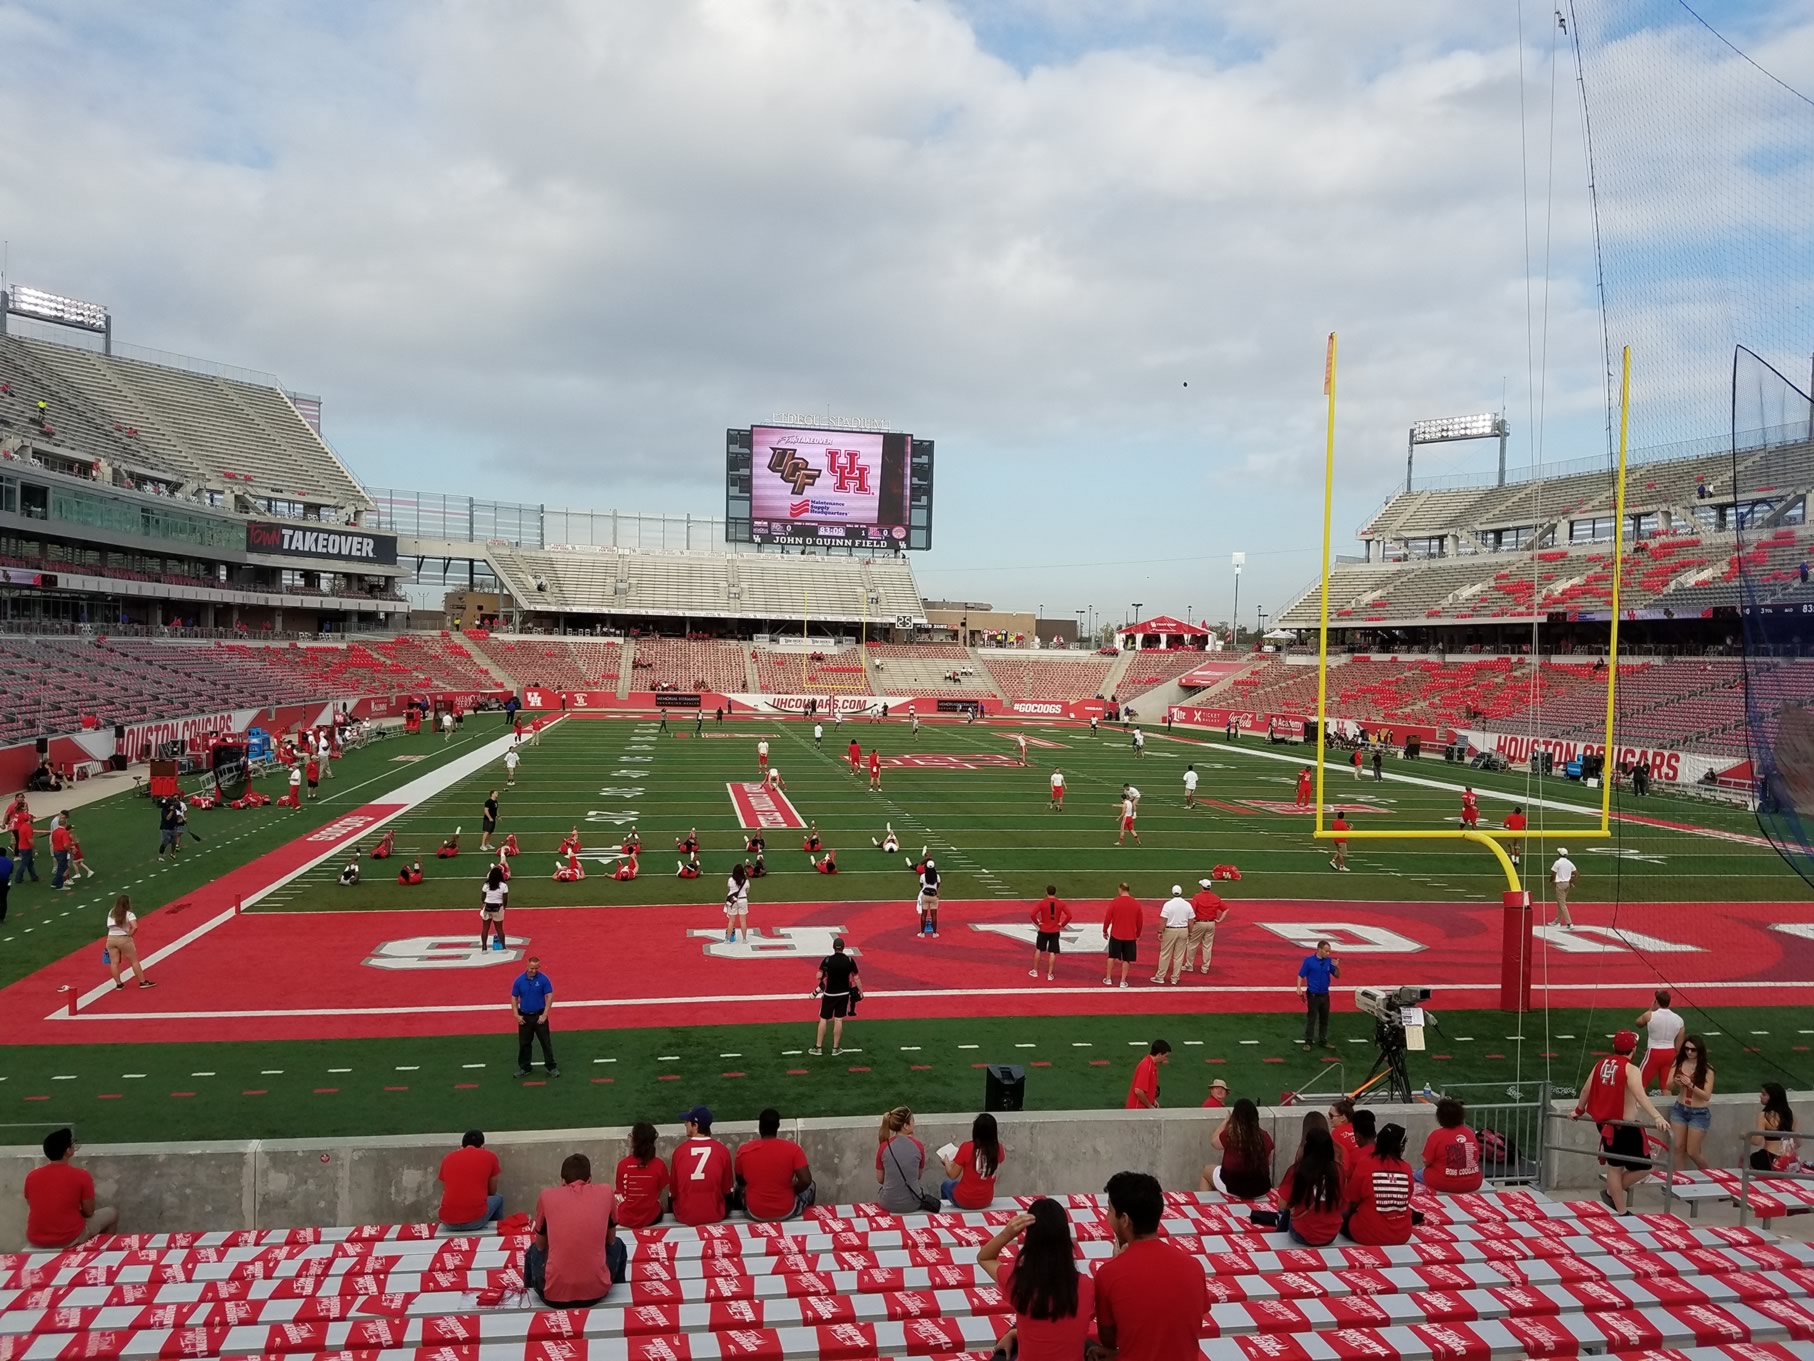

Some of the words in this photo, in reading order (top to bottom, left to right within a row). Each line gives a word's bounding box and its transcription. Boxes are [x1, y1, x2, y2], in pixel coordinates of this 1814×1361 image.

[767, 447, 822, 495] UCF
[825, 448, 871, 494] UH
[819, 526, 845, 535] 83:09
[282, 529, 374, 558] TAKEOVER
[773, 536, 803, 544] JOHN
[806, 538, 852, 546] O'QUINN
[855, 540, 888, 548] FIELD
[898, 616, 911, 627] 25
[526, 692, 542, 706] UH
[772, 696, 867, 711] UHCOUARS.COM
[1013, 703, 1062, 713] #GOCOOGS
[115, 722, 179, 764] HOUSTON
[1496, 735, 1578, 769] HOUSTON
[690, 1147, 711, 1180] 7
